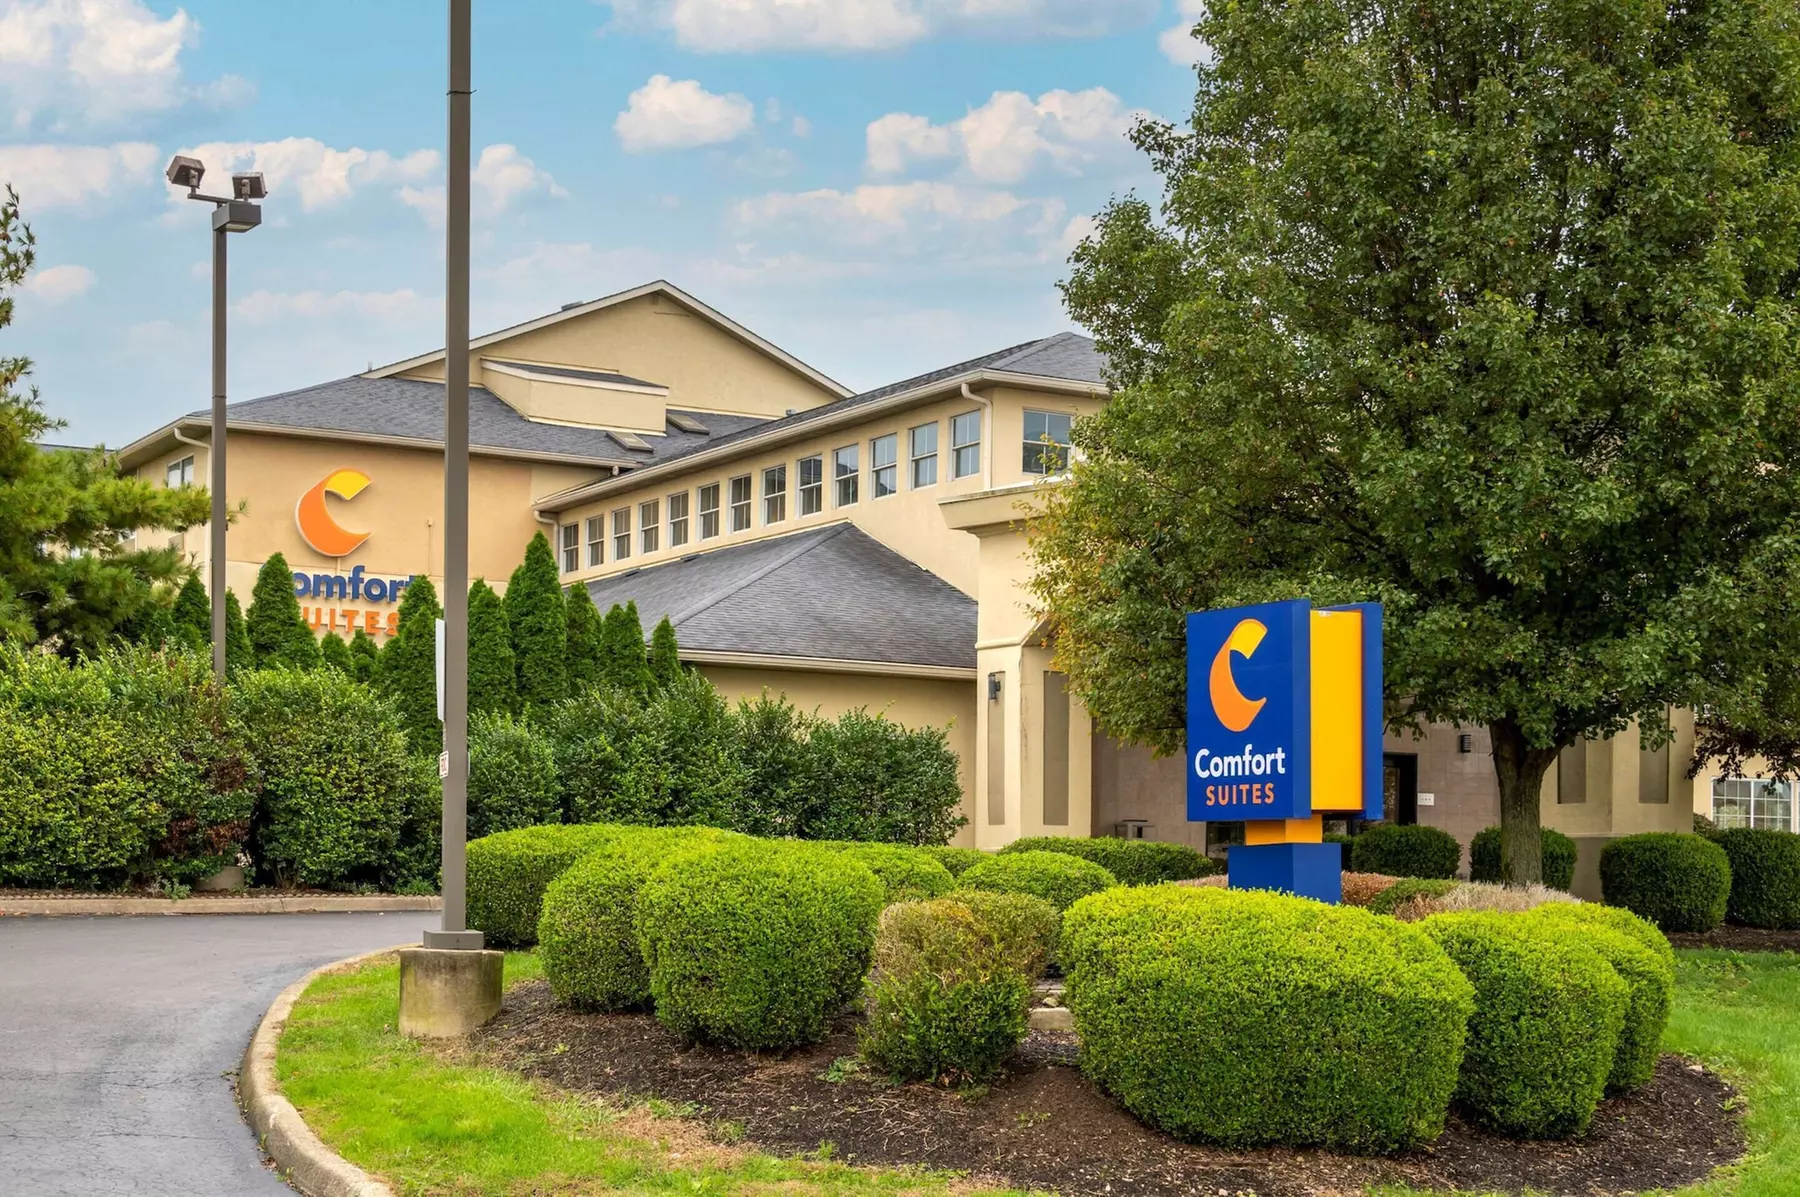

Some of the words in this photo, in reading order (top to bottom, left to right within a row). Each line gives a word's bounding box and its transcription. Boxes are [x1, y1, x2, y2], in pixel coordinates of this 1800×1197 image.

[260, 563, 416, 603] omfor
[302, 606, 399, 637] UITES
[1194, 743, 1286, 779] Comfort
[1206, 782, 1275, 806] SUITES
